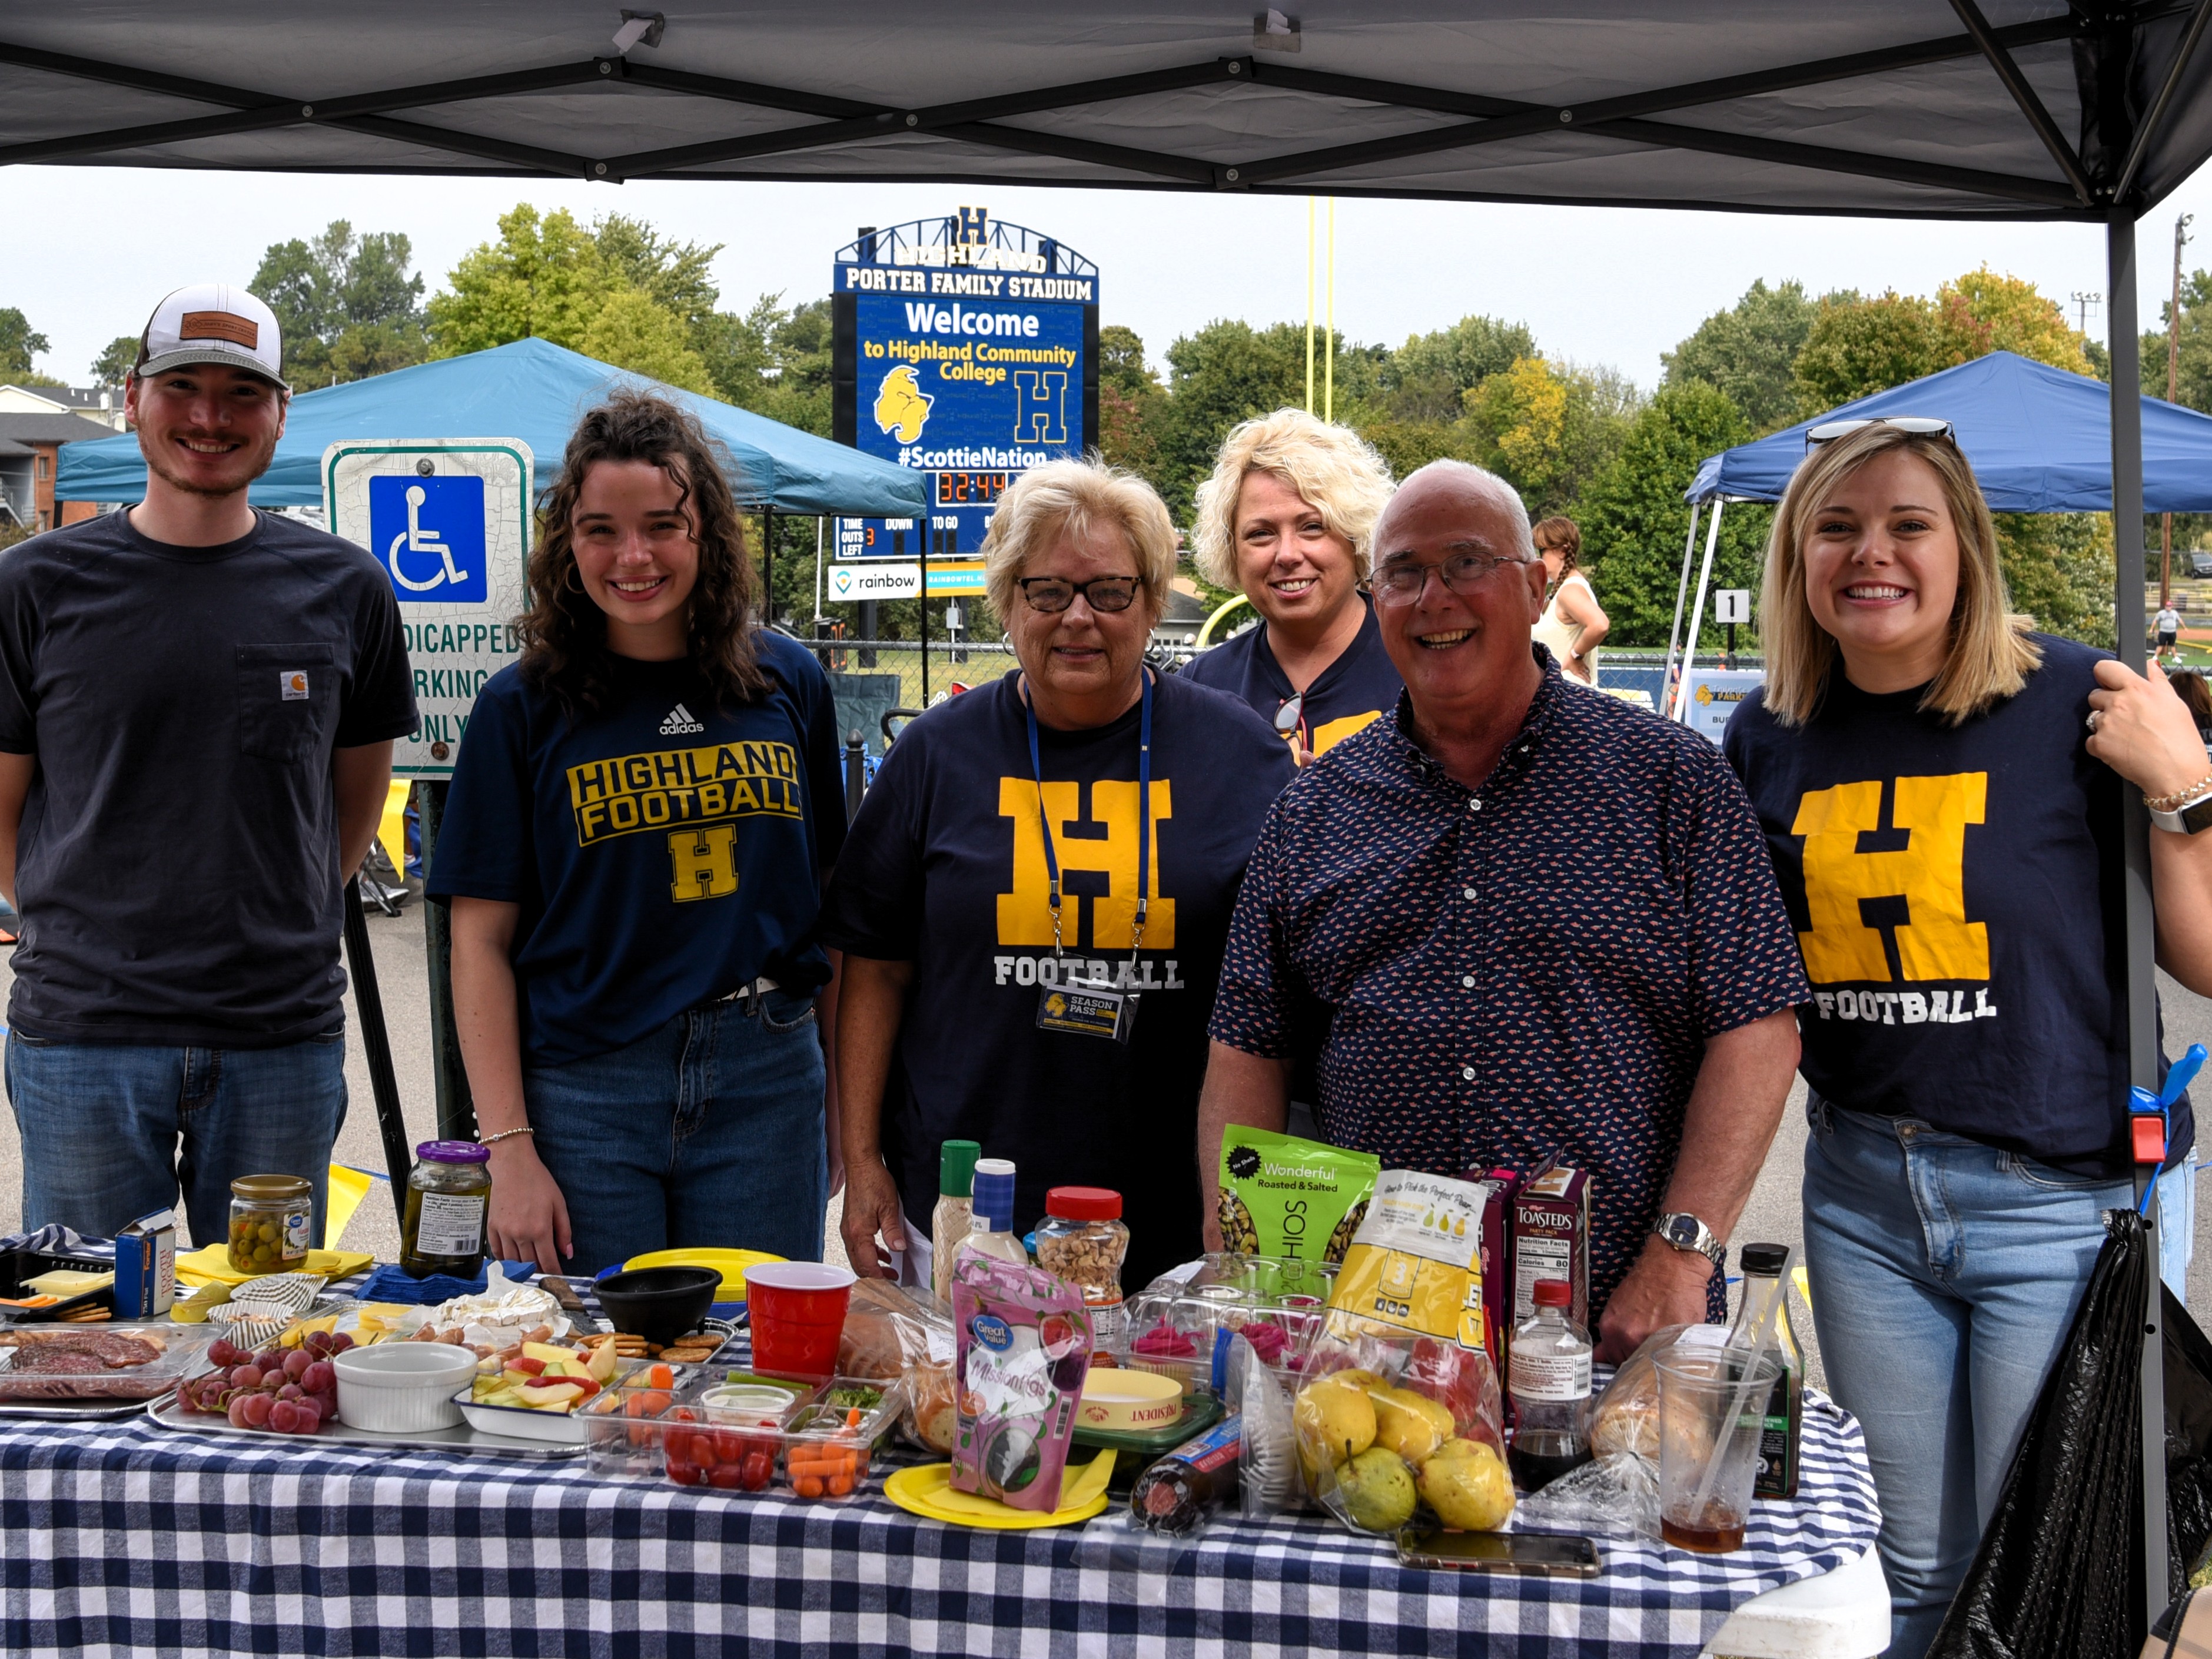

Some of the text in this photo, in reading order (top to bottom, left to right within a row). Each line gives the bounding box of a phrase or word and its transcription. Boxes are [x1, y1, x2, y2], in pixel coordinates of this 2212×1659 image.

[958, 205, 988, 246] H
[894, 245, 1047, 274] HIGHLAND
[846, 267, 1092, 300] PORTER FAMILY STADIUM
[905, 302, 1039, 337] Welcome
[864, 340, 1076, 369] to Highland Community
[939, 361, 1006, 386] College
[1014, 371, 1067, 443] H
[898, 446, 1047, 469] #ScottieNation
[843, 518, 863, 530] TIME
[885, 517, 913, 530] DOWN
[932, 516, 958, 529] TO GO
[842, 531, 863, 543] OUTS
[866, 528, 875, 546] 3
[842, 545, 863, 556] LEFT
[859, 573, 915, 589] rainbow
[1728, 595, 1735, 618] 1
[659, 722, 704, 735] adidas
[575, 744, 794, 803] HIGHLAND
[581, 778, 799, 838] FOOTBALL
[667, 824, 739, 903] H
[997, 777, 1175, 950] H
[1791, 771, 1990, 984] H
[994, 955, 1184, 990] FOOTBALL
[1070, 1004, 1096, 1016] PASS
[1071, 996, 1113, 1010] SEASON
[1814, 987, 1997, 1026] FOOTBALL
[1241, 1156, 1256, 1166] Shells
[1264, 1162, 1335, 1180] Wonderful
[1258, 1179, 1338, 1192] Roasted & Salted
[1404, 1181, 1419, 1192] Pick
[1429, 1184, 1454, 1202] Perfect
[1517, 1206, 1573, 1230] TOASTEDS
[1519, 1237, 1548, 1246] Nutrition
[1393, 1262, 1407, 1285] 3
[1383, 1282, 1409, 1293] POUNDS
[977, 1320, 1006, 1339] Great
[984, 1332, 1007, 1346] Value
[971, 1359, 1046, 1398] Mission Figs
[1131, 1403, 1177, 1423] PRÉSIDENT
